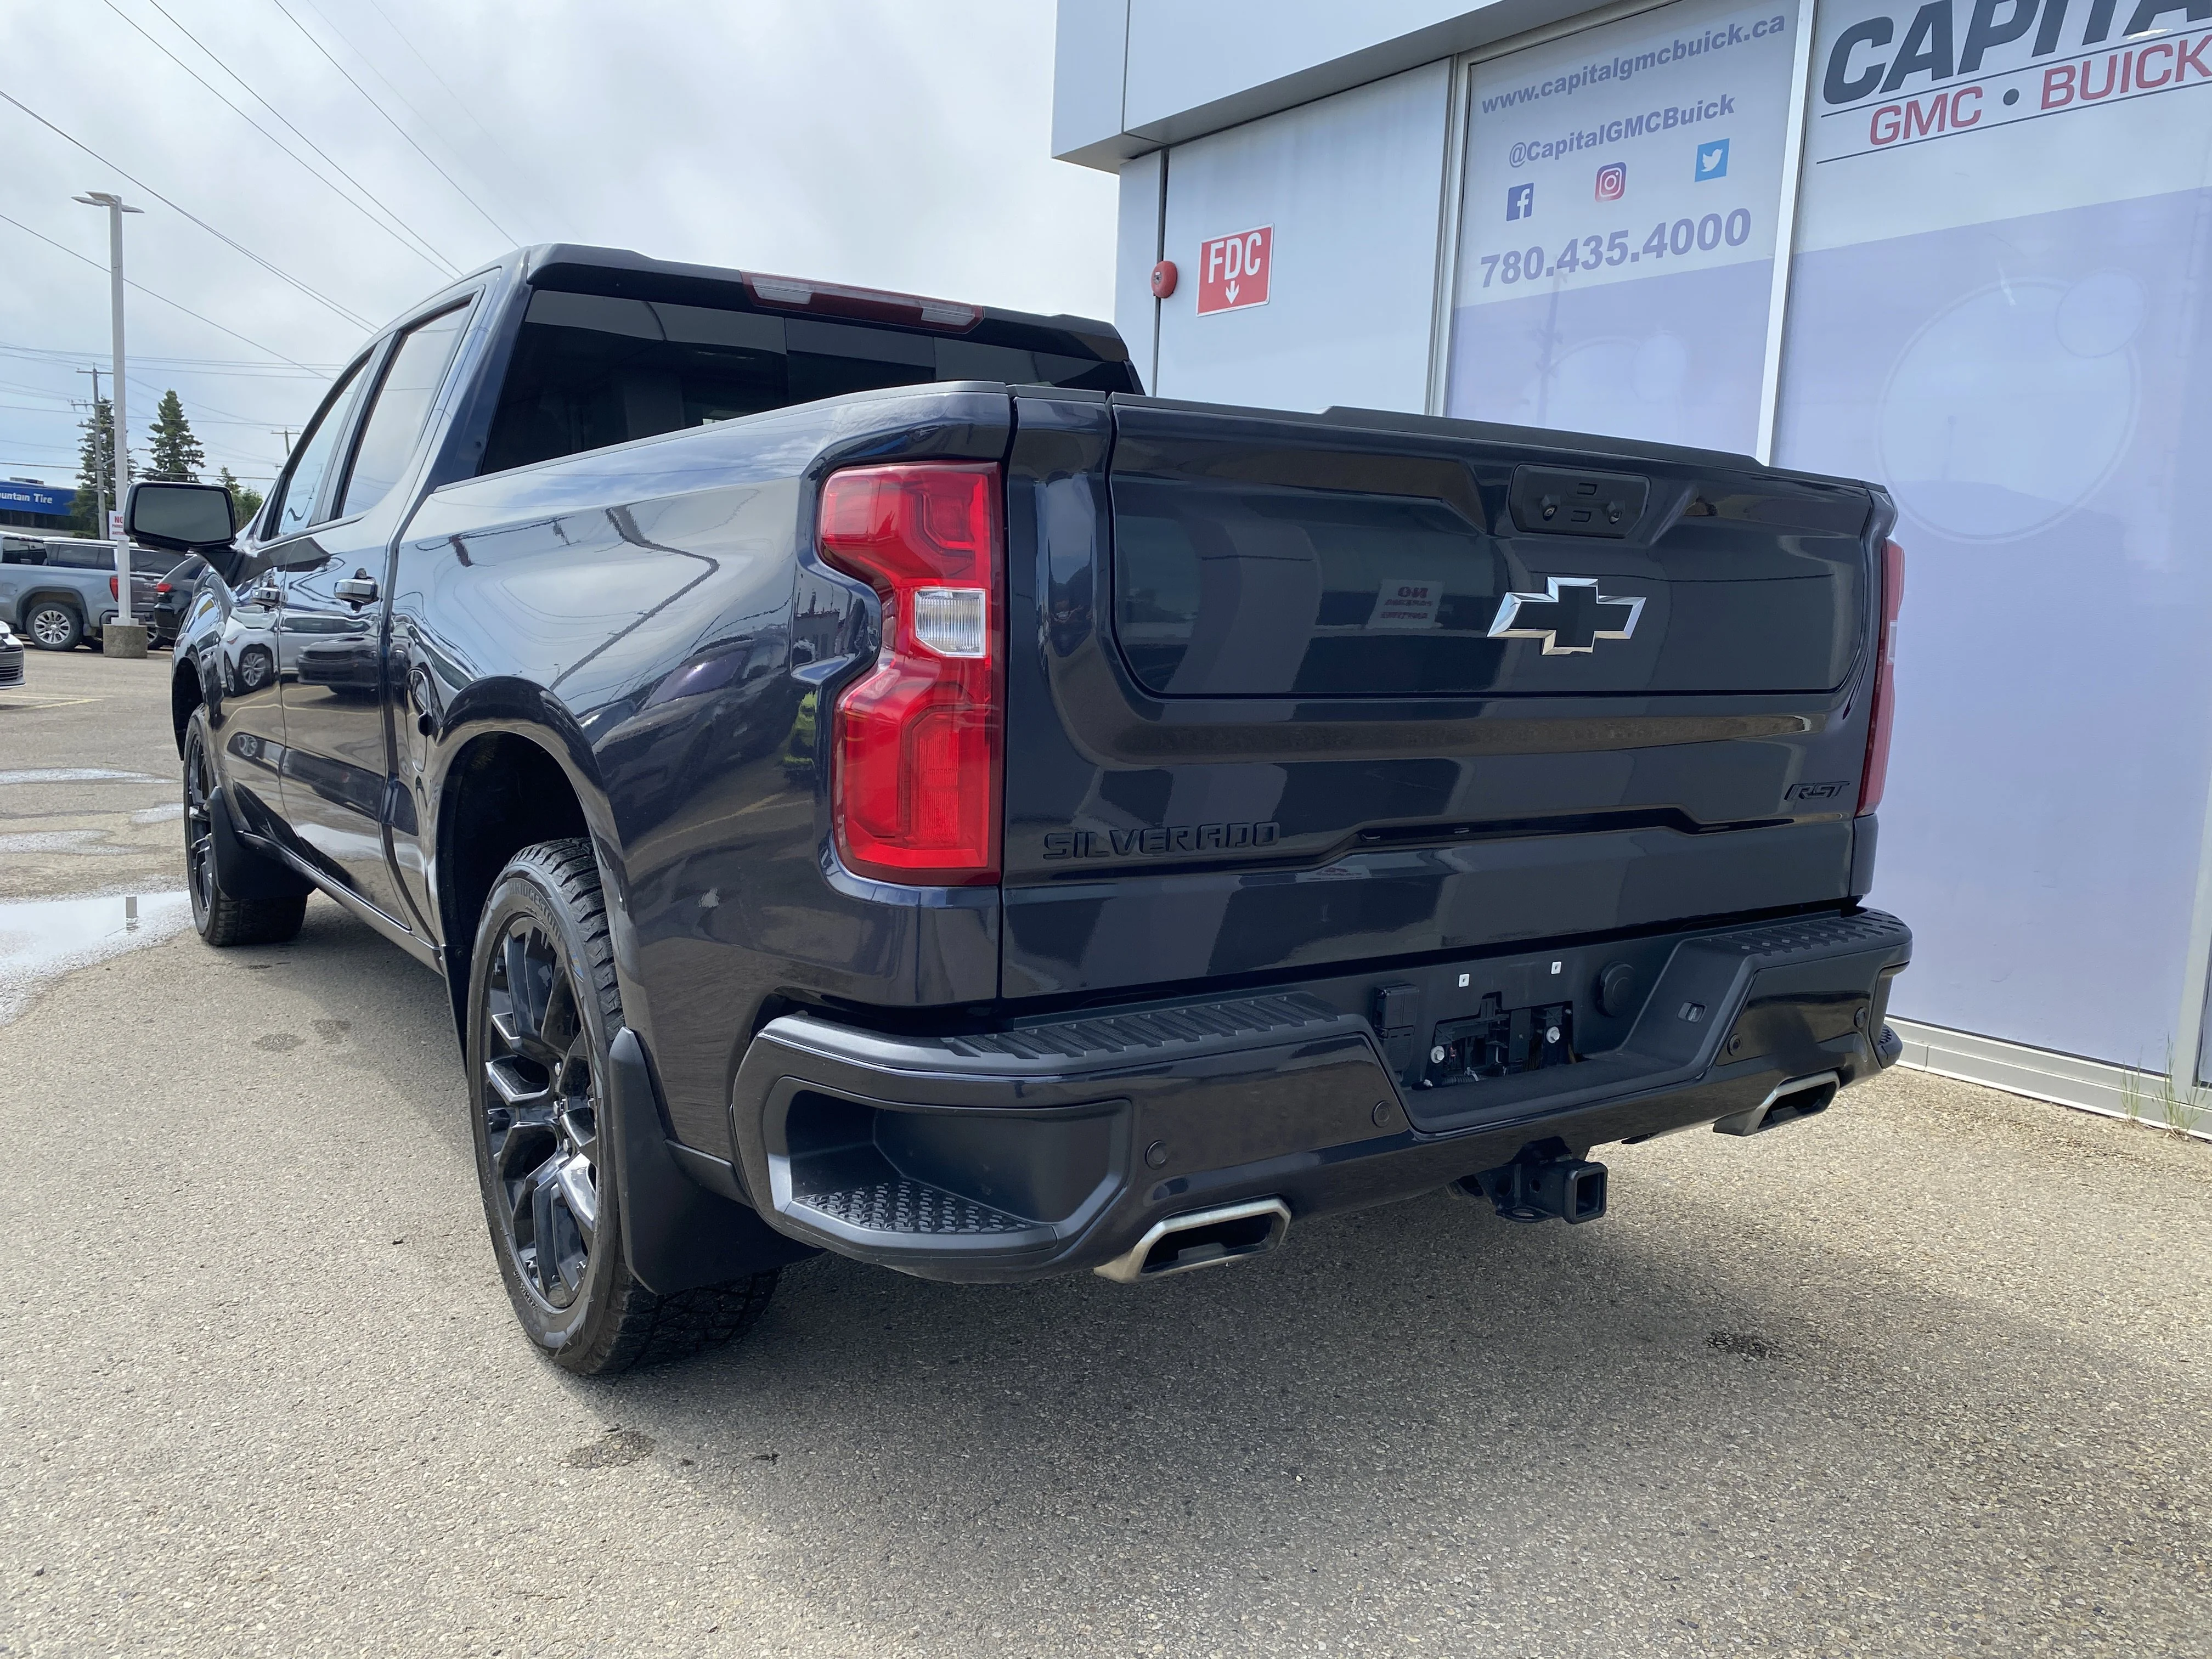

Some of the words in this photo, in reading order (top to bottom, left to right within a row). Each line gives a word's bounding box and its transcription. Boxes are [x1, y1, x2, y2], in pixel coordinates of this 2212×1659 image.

[1481, 15, 1785, 114] www.capitalgmcbuick.ca
[1870, 86, 1983, 145] GMC
[2041, 35, 2212, 110] BUICK
[1509, 94, 1735, 168] @CapitalGMCBuick
[1208, 232, 1262, 283] FDC
[1481, 208, 1751, 287] 780.435.4000
[0, 493, 30, 501] untain
[33, 493, 53, 504] Tire
[1784, 781, 1850, 800] RST
[1043, 821, 1281, 860] SILVERADO
